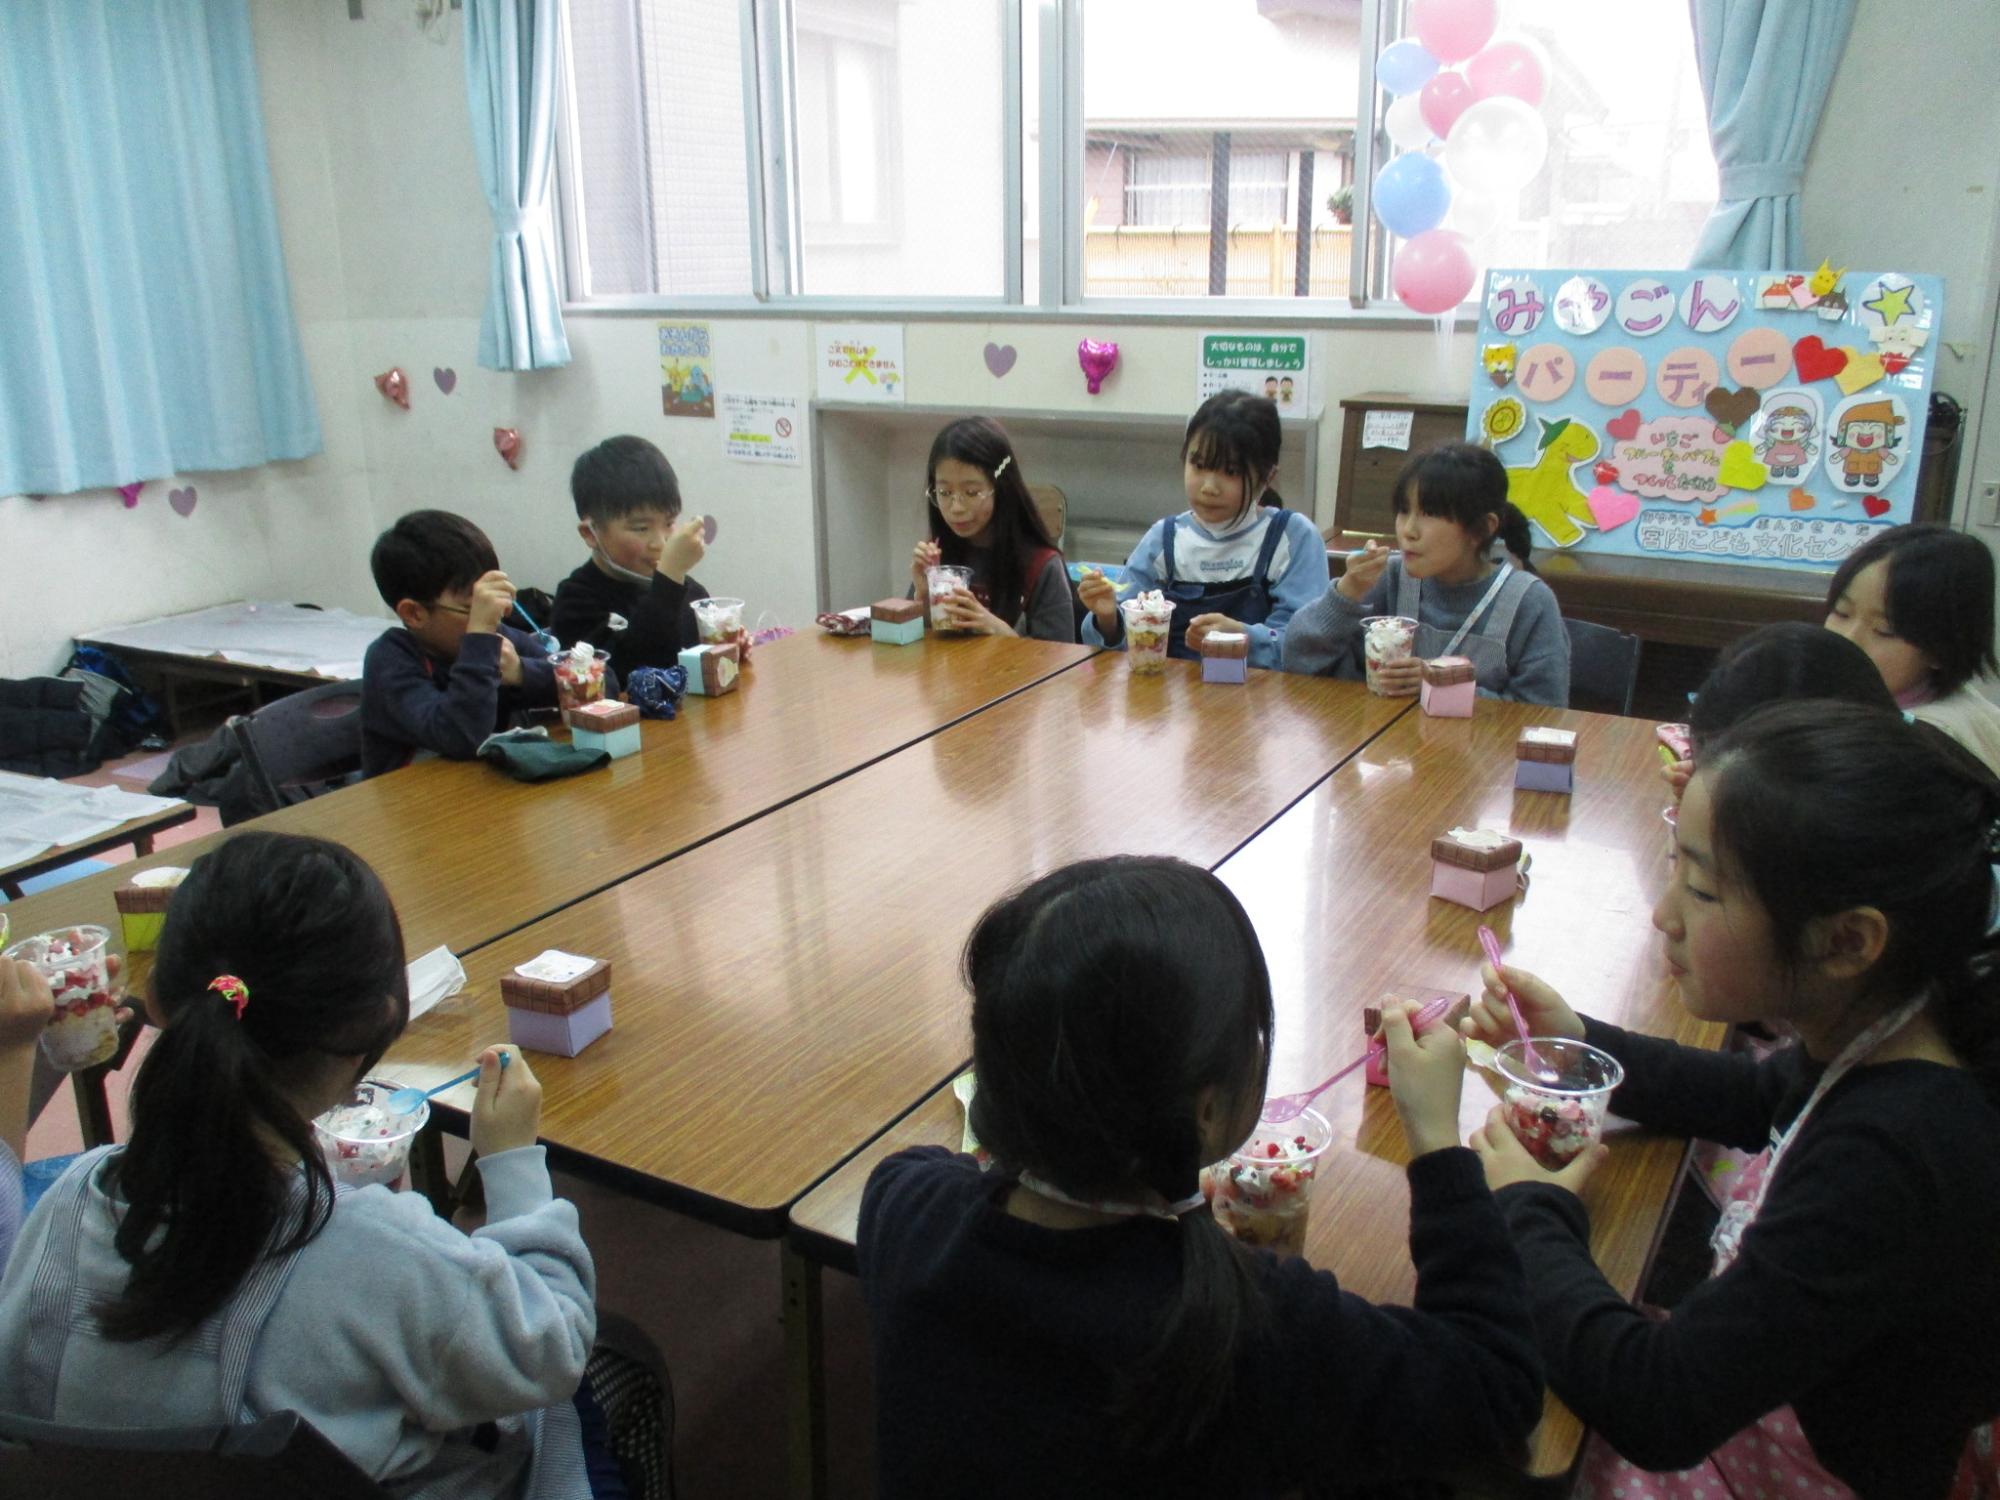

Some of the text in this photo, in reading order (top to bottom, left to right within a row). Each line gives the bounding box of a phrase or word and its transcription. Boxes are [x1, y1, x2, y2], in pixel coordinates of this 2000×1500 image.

[1206, 357, 1301, 369] しっかり管理しましょう
[1650, 430, 1699, 449] いちご
